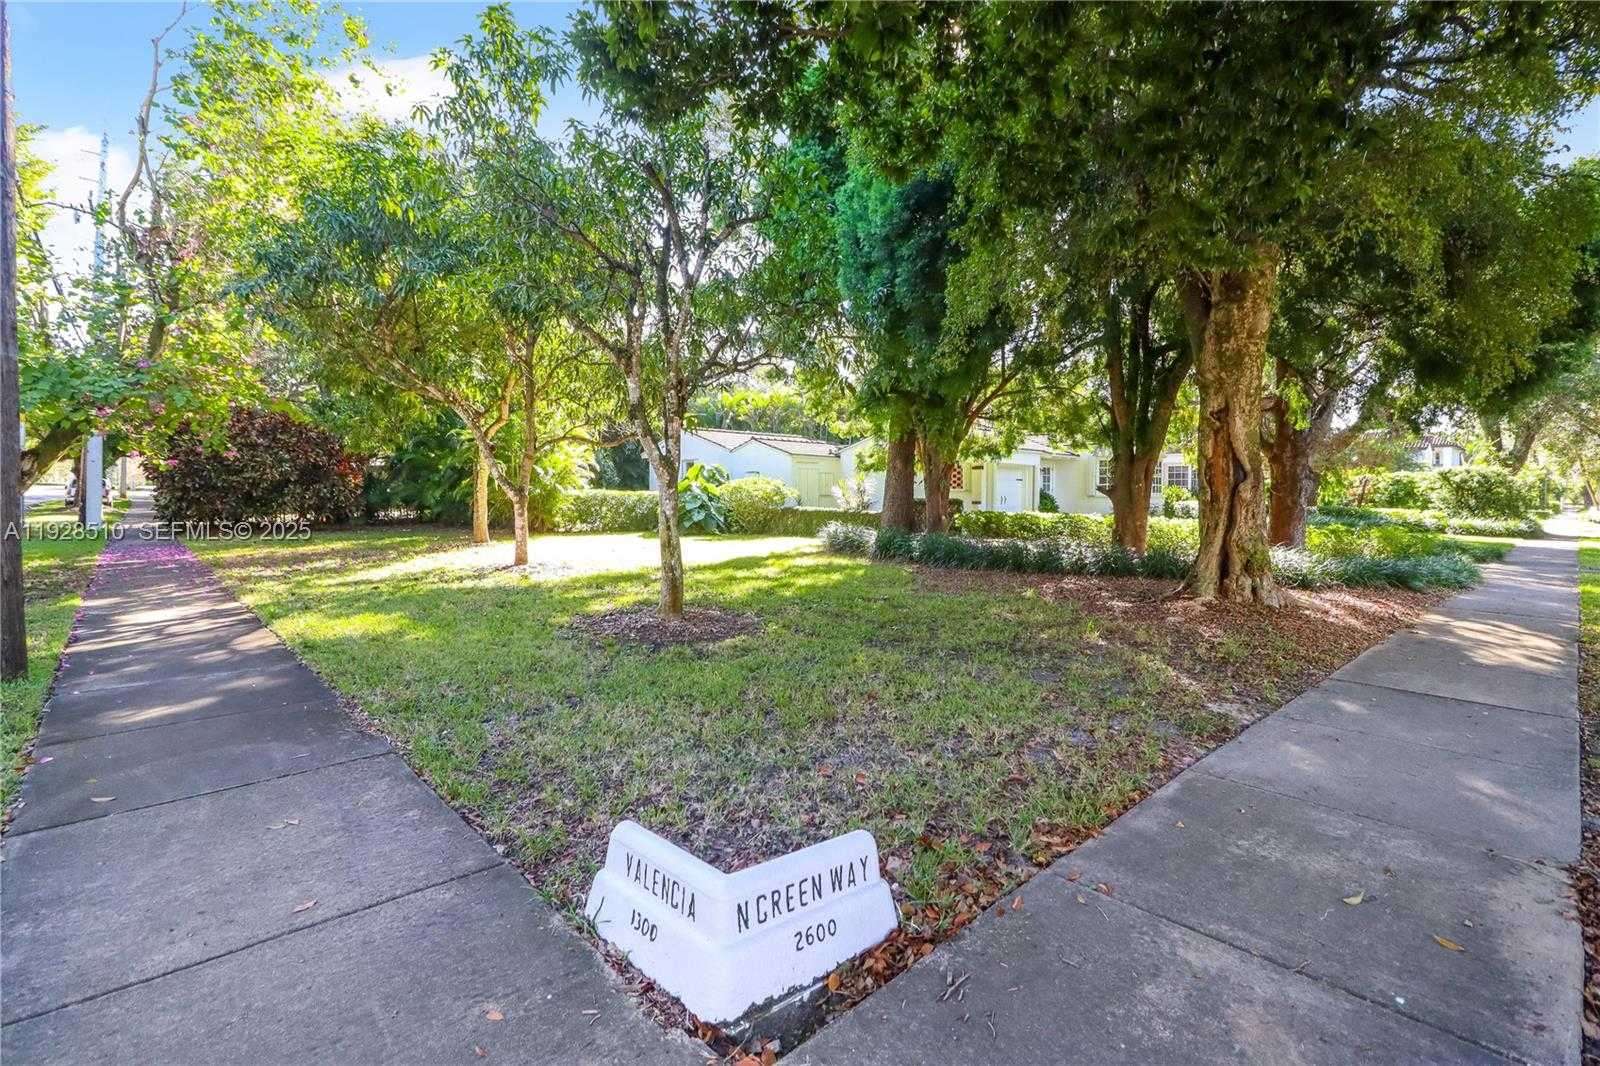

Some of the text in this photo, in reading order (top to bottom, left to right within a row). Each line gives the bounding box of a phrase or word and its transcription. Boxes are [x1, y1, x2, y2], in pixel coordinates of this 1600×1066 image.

[625, 852, 697, 922] VALENCIA
[736, 900, 750, 934] N
[829, 855, 870, 893] WAY
[630, 909, 658, 942] 1300
[794, 918, 837, 951] 2600
